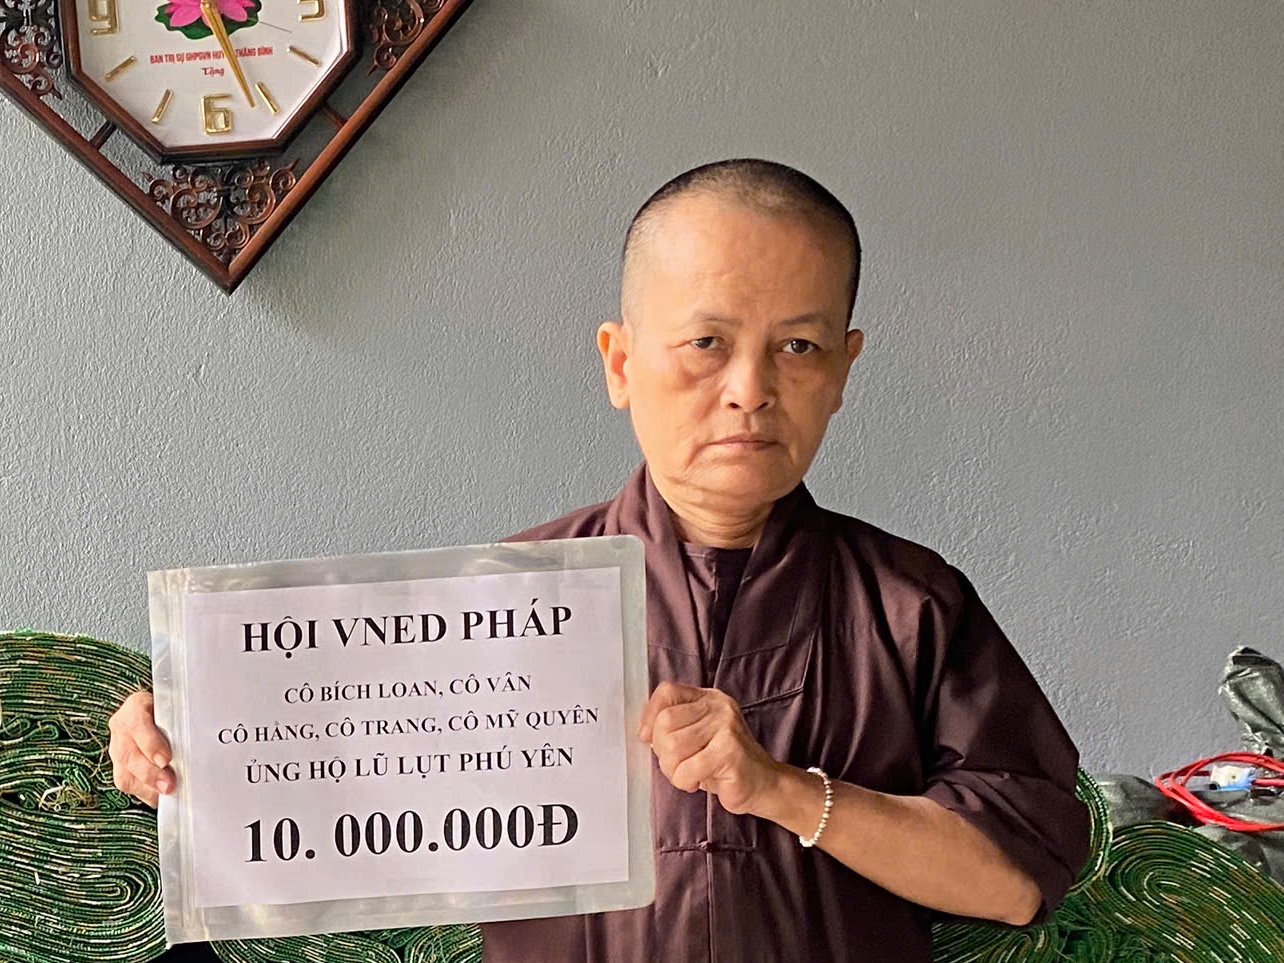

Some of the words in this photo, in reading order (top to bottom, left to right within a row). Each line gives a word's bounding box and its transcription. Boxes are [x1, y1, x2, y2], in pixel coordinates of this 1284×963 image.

[149, 54, 164, 64] BAN
[201, 94, 234, 135] 6
[241, 615, 320, 659] HỘI
[331, 613, 447, 648] VNED
[460, 598, 572, 641] PHÁP
[284, 682, 314, 704] CÔ
[320, 681, 371, 702] BÍCH
[378, 680, 444, 699] LOAN,
[449, 673, 480, 695] CÔ
[487, 671, 532, 693] VÂN
[218, 723, 249, 744] CÔ
[325, 717, 355, 737] CÔ
[361, 716, 442, 735] TRANG,
[448, 710, 479, 731] CÔ
[485, 709, 519, 730] MỸ
[525, 704, 599, 730] QUYÊN
[245, 759, 301, 783] ỦNG
[308, 756, 346, 783] HỘ
[355, 752, 388, 776] LŨ
[397, 754, 451, 778] LỤT
[459, 745, 513, 772] PHÚ
[521, 742, 574, 769] YÊN
[244, 818, 316, 862] 10.
[334, 803, 579, 857] 000.000Đ
